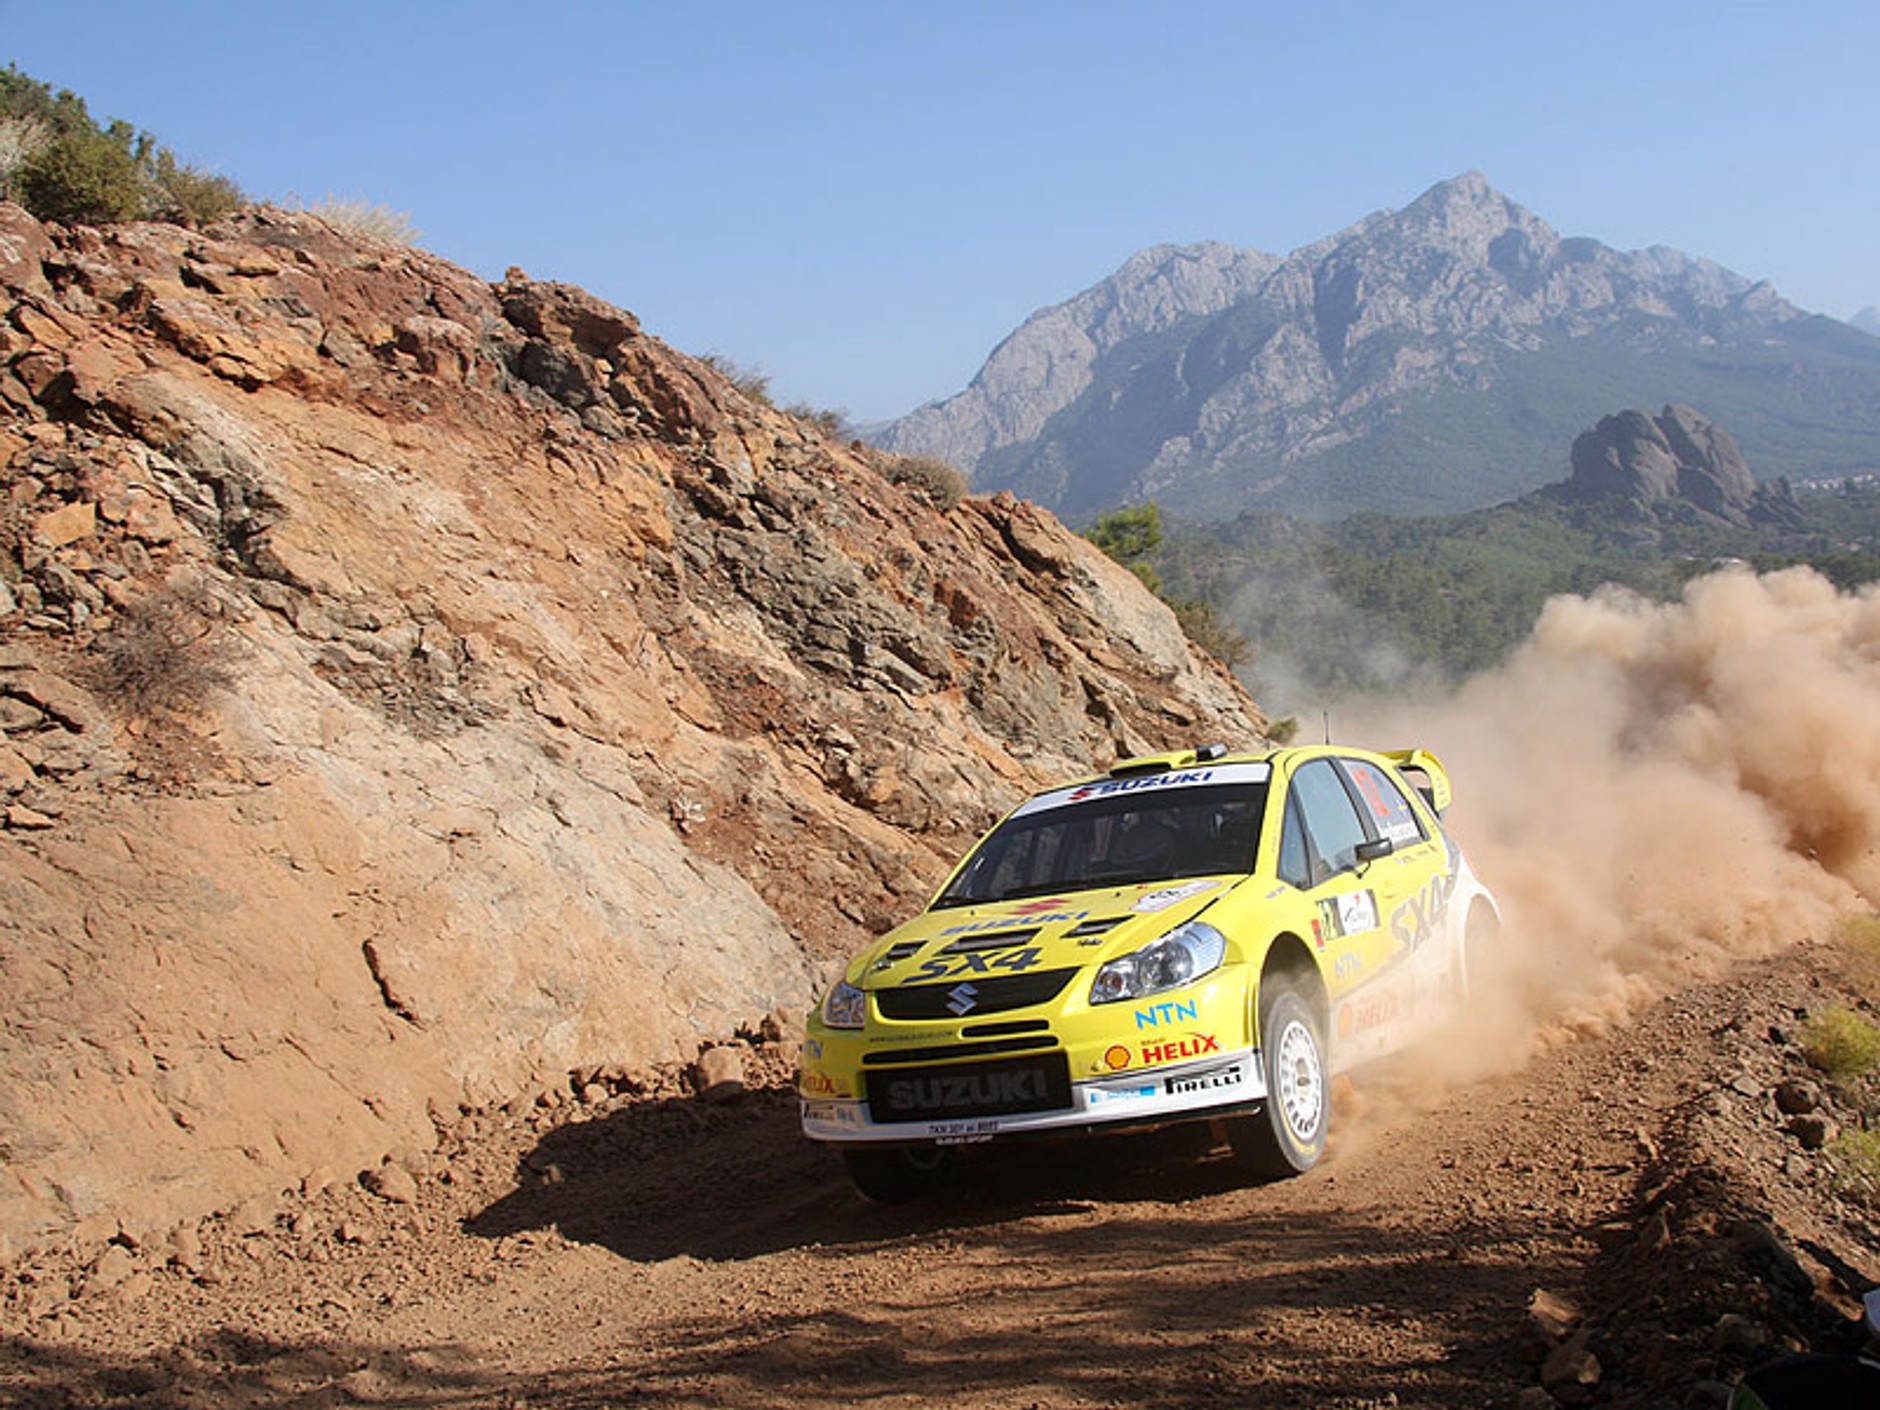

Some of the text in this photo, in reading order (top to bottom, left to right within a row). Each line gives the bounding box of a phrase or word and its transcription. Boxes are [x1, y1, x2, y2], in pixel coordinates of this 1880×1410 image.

[1099, 771, 1213, 795] SUZUKI
[940, 911, 1091, 937] SUZUKI
[902, 947, 1043, 984] SX4
[1134, 998, 1198, 1030] NTN
[1141, 1032, 1220, 1064] HELIX
[888, 1068, 1049, 1110] SUZUKI
[1164, 1066, 1242, 1096] PIRELLI
